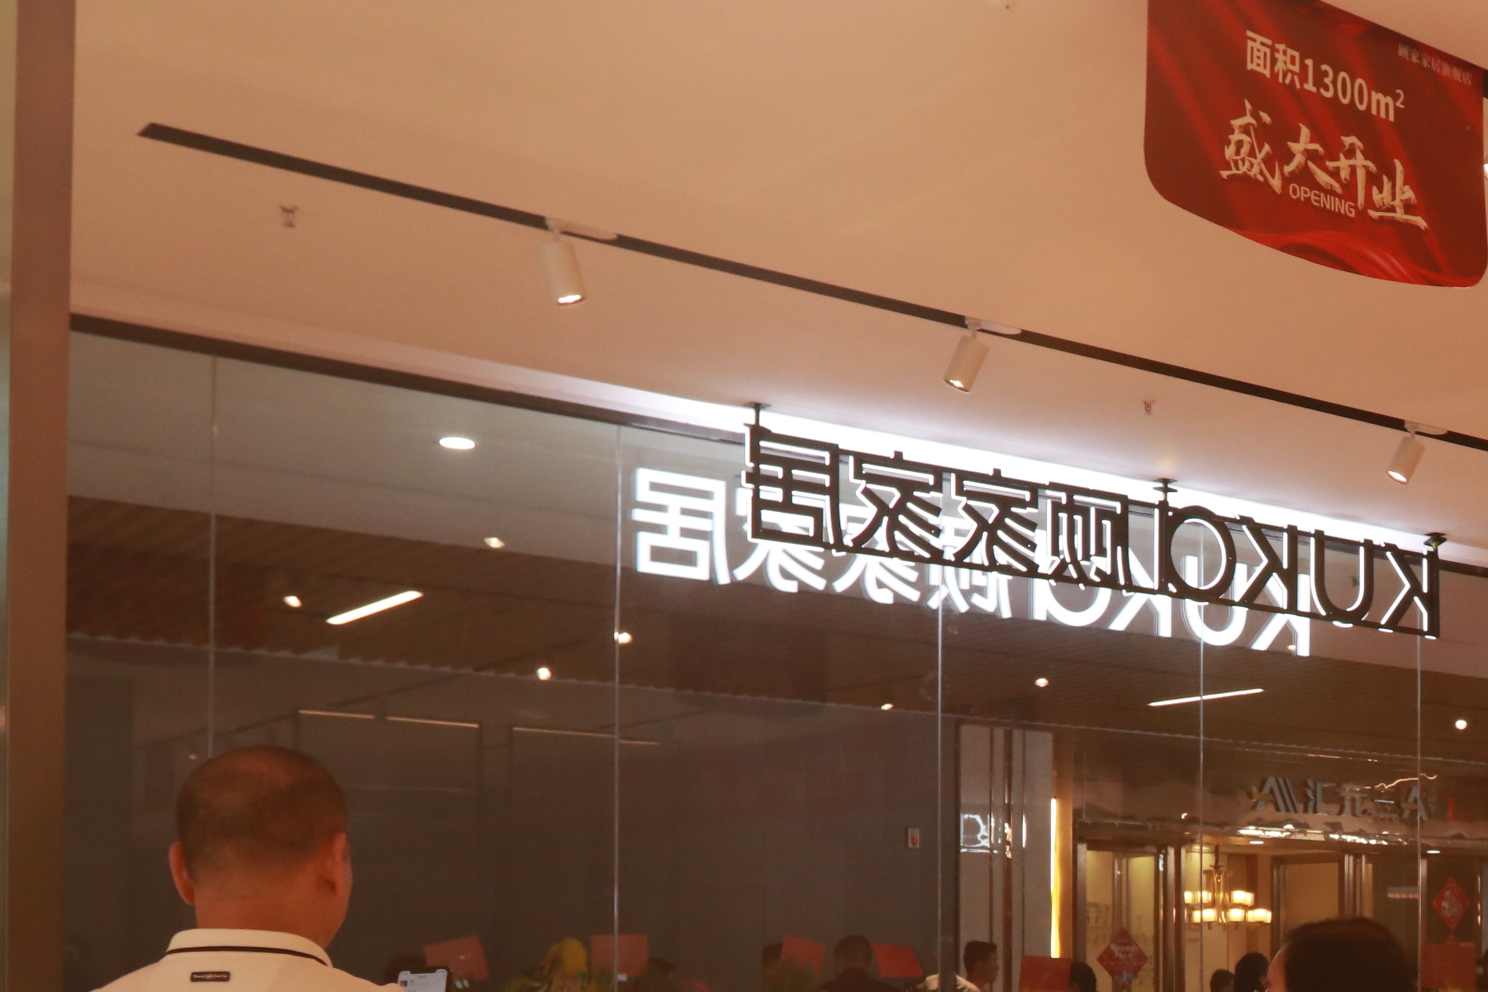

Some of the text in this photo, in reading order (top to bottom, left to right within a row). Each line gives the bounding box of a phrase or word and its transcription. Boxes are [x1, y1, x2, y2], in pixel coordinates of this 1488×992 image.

[1219, 98, 1428, 230] 盛大开业
[1288, 182, 1356, 218] OPENING
